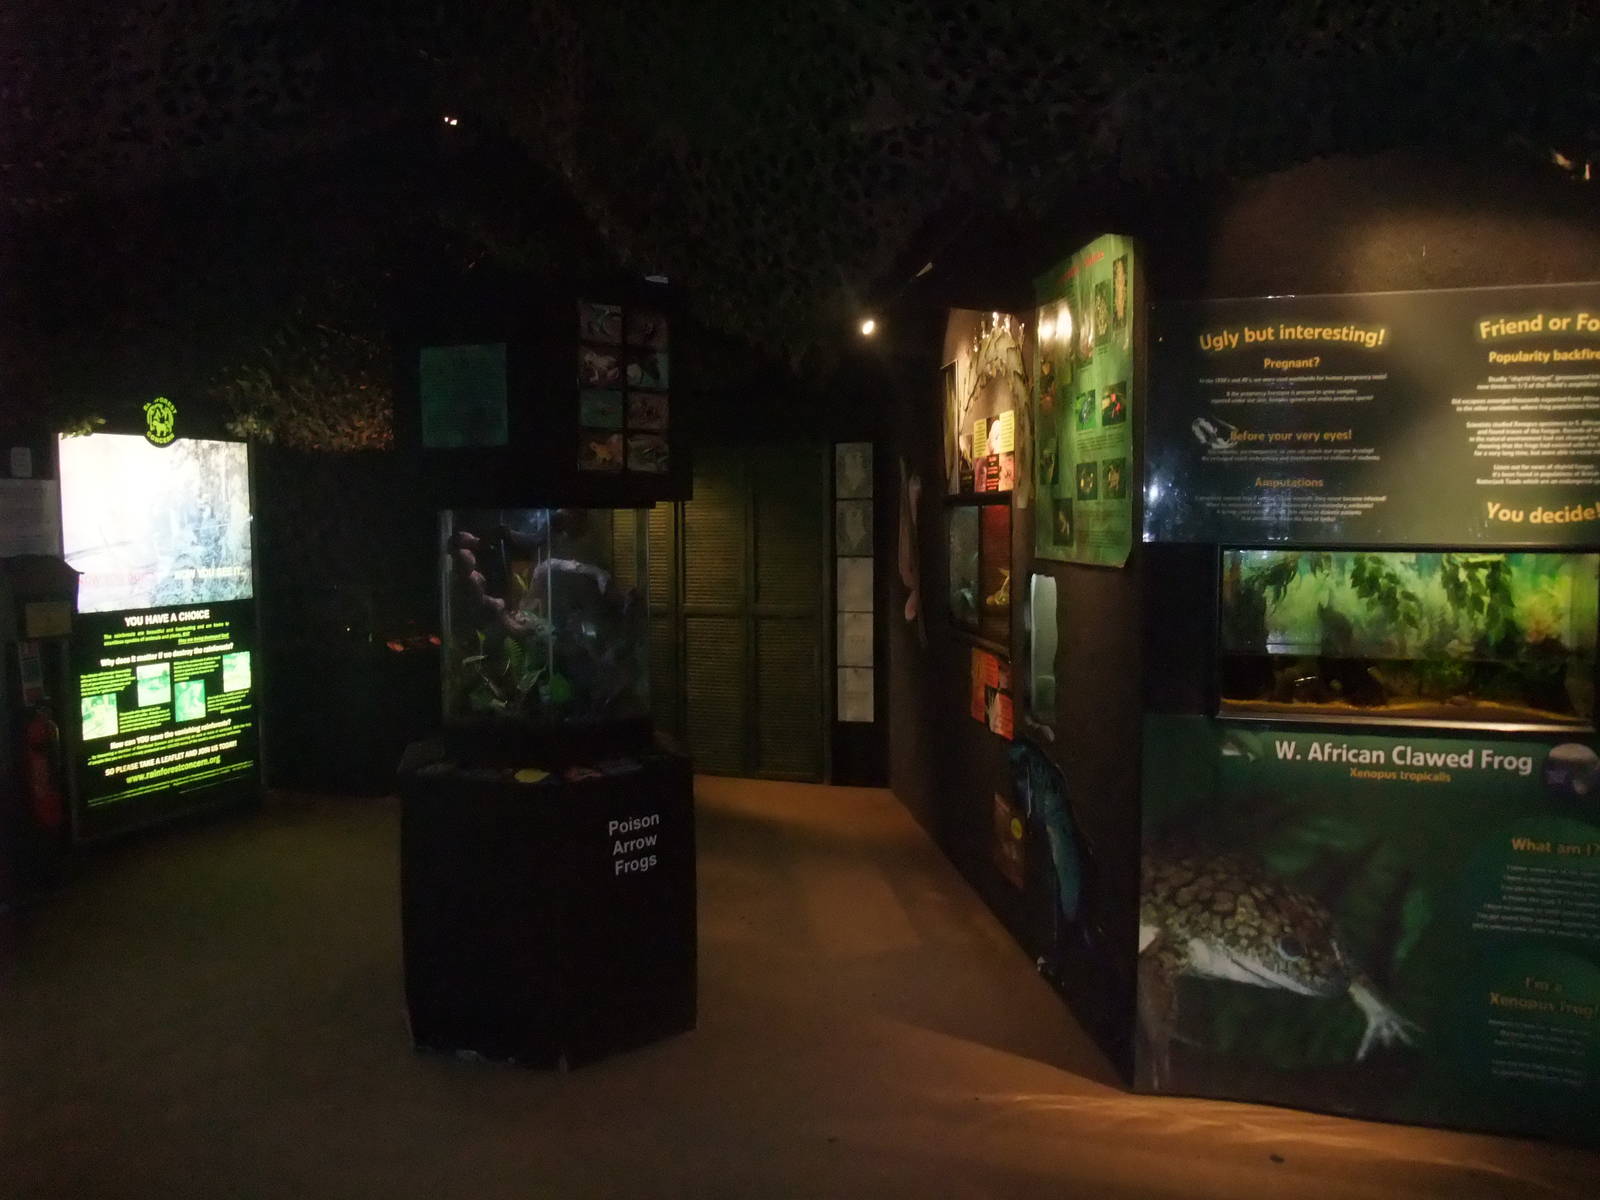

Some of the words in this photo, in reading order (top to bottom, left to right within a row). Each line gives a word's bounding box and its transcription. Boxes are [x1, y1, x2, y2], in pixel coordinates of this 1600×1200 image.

[1199, 329, 1240, 351] Ugly
[1244, 325, 1275, 343] but
[1279, 323, 1386, 348] interesting!
[1480, 313, 1544, 339] Friend
[1548, 316, 1572, 331] or
[1263, 355, 1321, 370] Pregnant?
[1488, 350, 1551, 364] Popularity
[1230, 430, 1265, 442] Before
[1267, 431, 1294, 442] your
[1296, 431, 1321, 443] very
[1323, 429, 1353, 442] eyes!
[1255, 477, 1324, 489] Amputations
[1486, 501, 1524, 523] You
[124, 615, 144, 628] YOU
[145, 613, 170, 626] HAVE
[170, 612, 178, 623] A
[178, 609, 210, 622] CHOICE
[100, 658, 115, 668] Why
[115, 655, 131, 666] does
[136, 652, 158, 662] matter
[158, 651, 163, 660] if
[163, 651, 172, 659] we
[172, 648, 194, 658] destroy
[193, 646, 203, 655] the
[109, 740, 124, 751] How
[124, 738, 136, 748] can
[136, 735, 149, 745] YOU
[164, 730, 174, 739] the
[104, 768, 115, 777] SO
[115, 763, 139, 775] PLEASE
[139, 759, 156, 770] TAKE
[155, 757, 161, 766] A
[160, 752, 185, 764] LEAFLET
[185, 749, 198, 758] AND
[198, 745, 211, 756] JOIN
[210, 743, 219, 752] US
[1274, 740, 1301, 761] W.
[1307, 742, 1385, 764] African
[1391, 745, 1474, 769] Clawed
[1480, 750, 1533, 776] Frog
[126, 755, 221, 784] www.rainforestconcern.org
[1350, 766, 1398, 781] Xenopus
[1399, 768, 1452, 783] tropicalis
[608, 814, 660, 837] Poison
[612, 833, 657, 857] Arrow
[1510, 837, 1552, 853] What
[615, 854, 657, 876] Frogs
